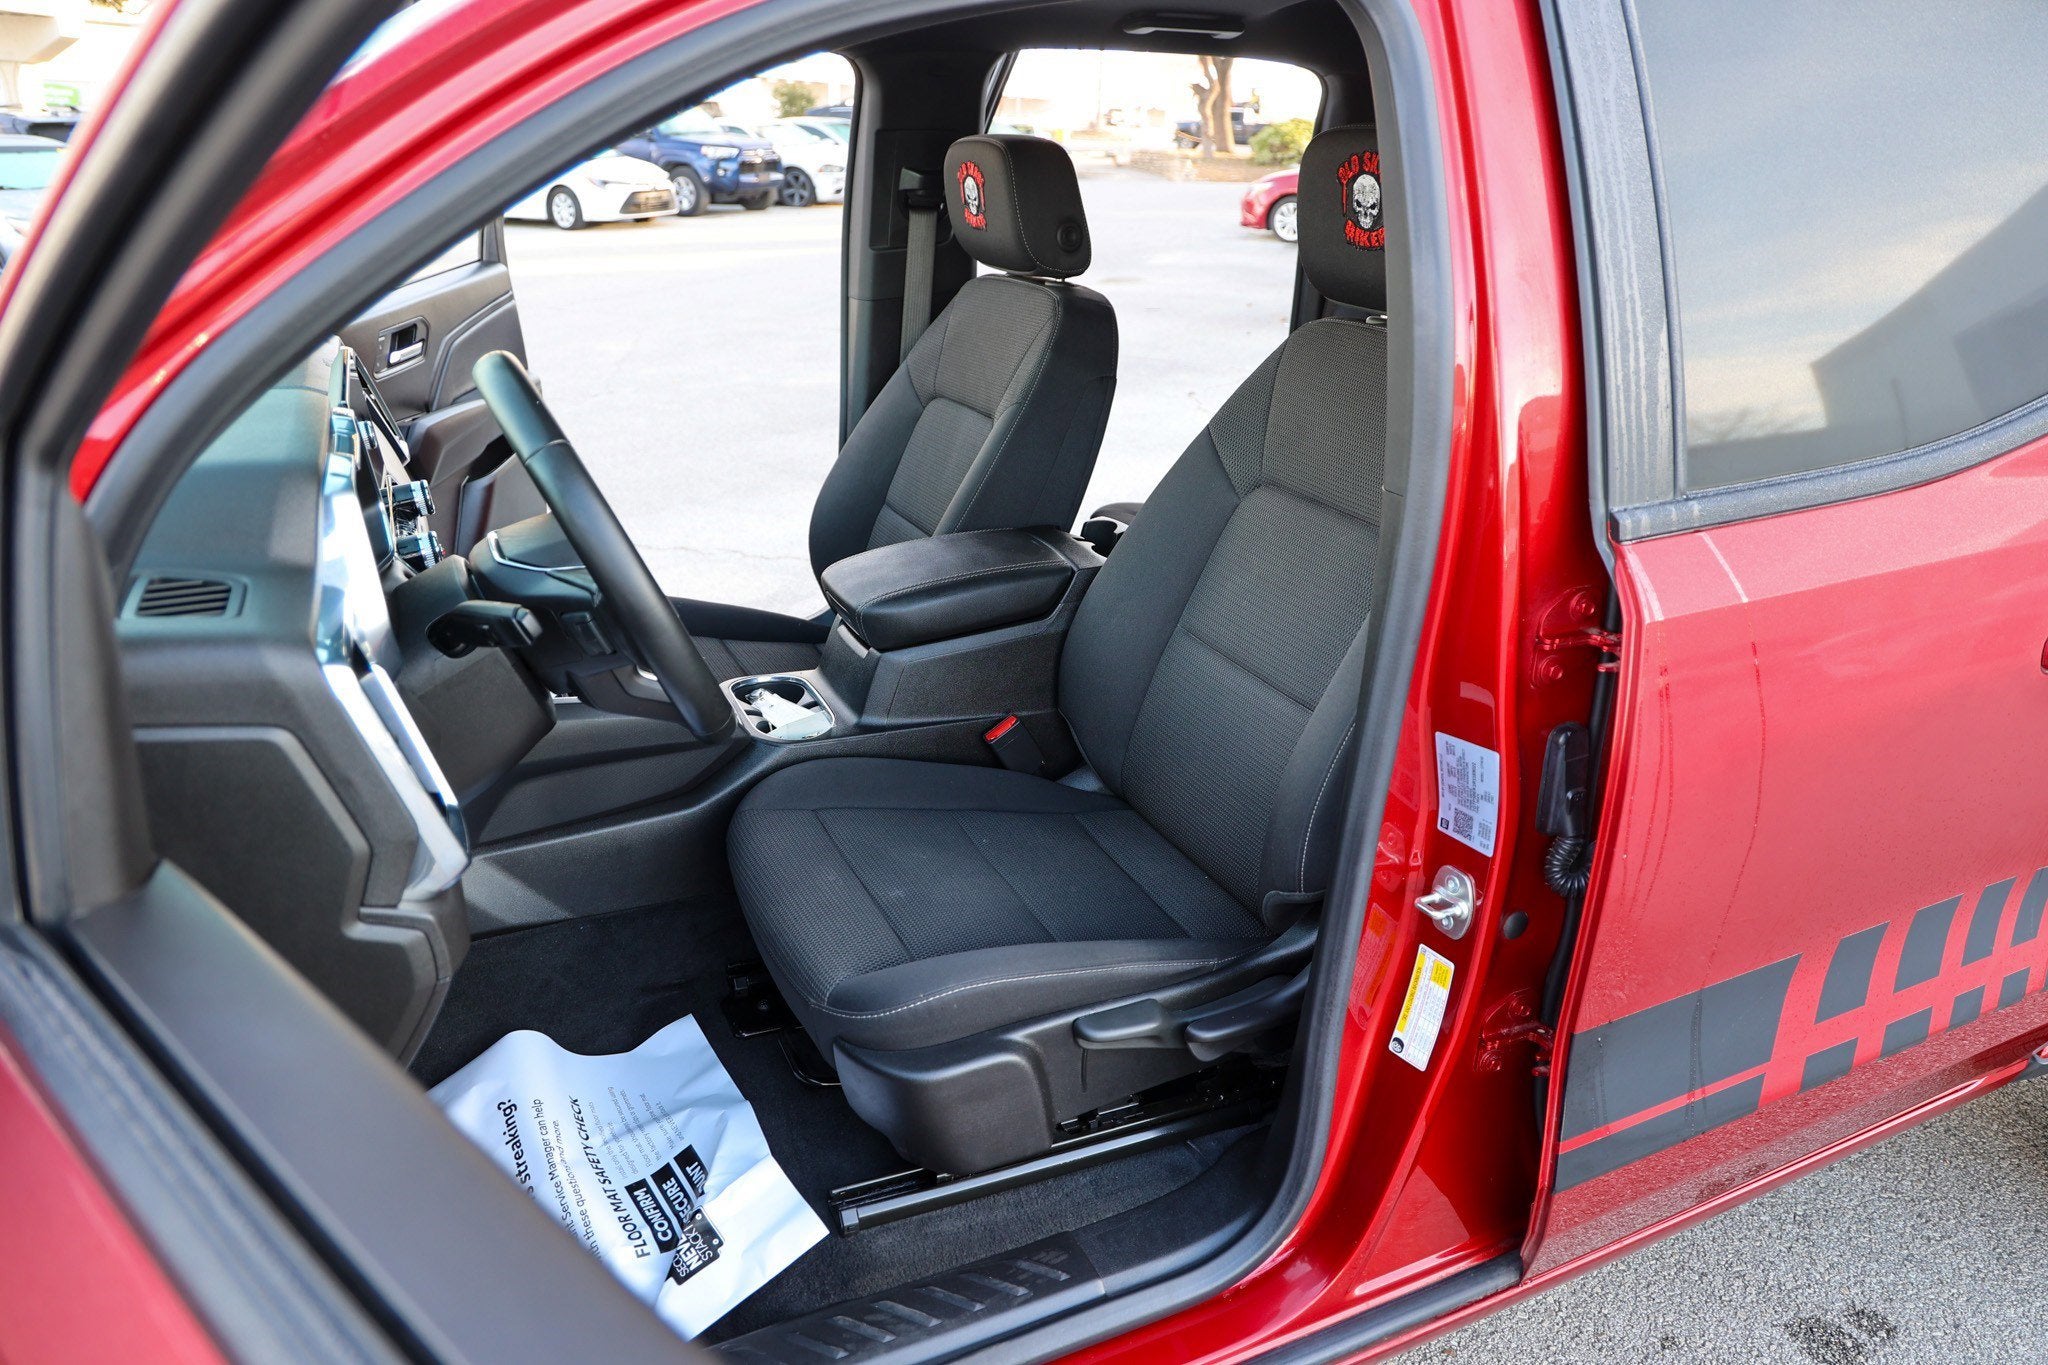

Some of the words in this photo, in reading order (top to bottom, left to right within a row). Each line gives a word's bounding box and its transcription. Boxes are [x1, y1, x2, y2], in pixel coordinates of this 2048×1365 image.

[1338, 154, 1359, 182] OLD
[1362, 152, 1380, 175] SK
[532, 1099, 544, 1119] help
[538, 1120, 548, 1136] can
[568, 1095, 590, 1140] CHECK
[497, 1099, 530, 1184] streaking?
[542, 1138, 559, 1181] Manager
[581, 1142, 612, 1184] SAFETY
[554, 1180, 571, 1220] Service
[562, 1162, 586, 1207] questions
[602, 1188, 626, 1212] MAT
[662, 1178, 691, 1223] SECURE
[580, 1208, 594, 1240] these
[634, 1187, 672, 1242] CONFIRM
[618, 1214, 650, 1258] FLOOR
[686, 1228, 713, 1261] STACK
